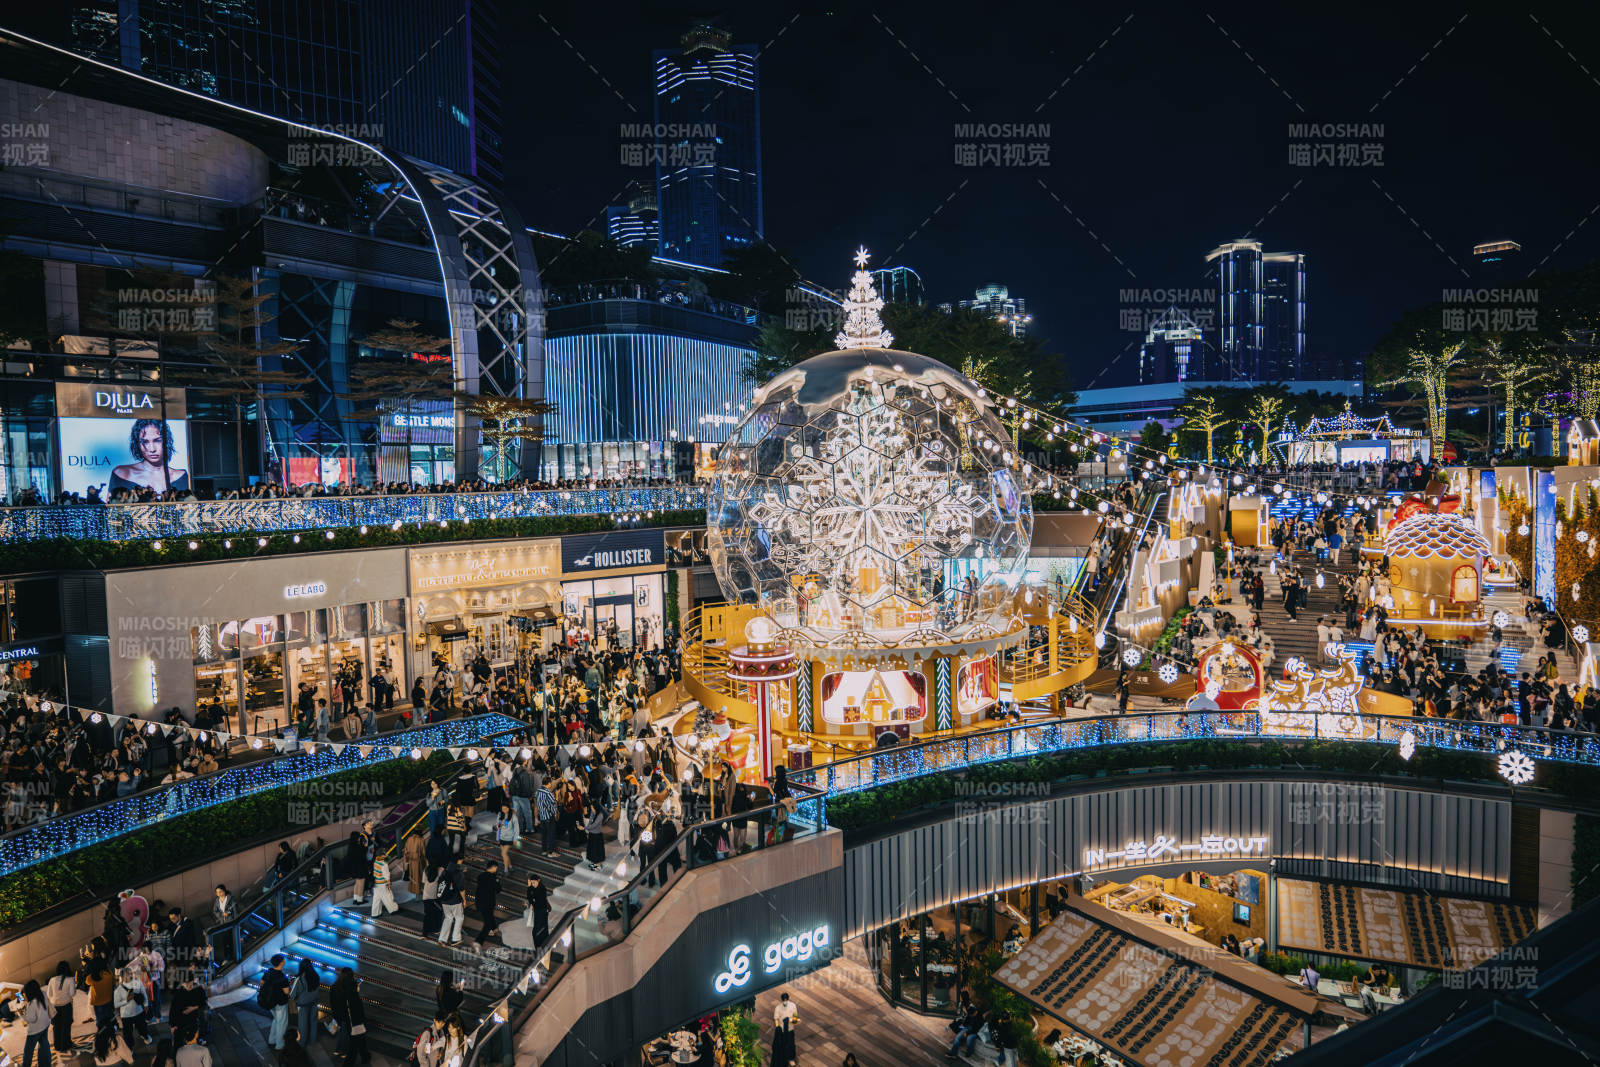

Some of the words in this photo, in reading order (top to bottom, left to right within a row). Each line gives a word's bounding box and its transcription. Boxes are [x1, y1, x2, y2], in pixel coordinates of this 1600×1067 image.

[96, 391, 153, 409] DJULA
[68, 455, 112, 467] DJULA
[594, 548, 652, 568] HOLLISTER
[287, 588, 299, 597] LE
[301, 584, 324, 595] LABO
[764, 924, 829, 974] gaga
